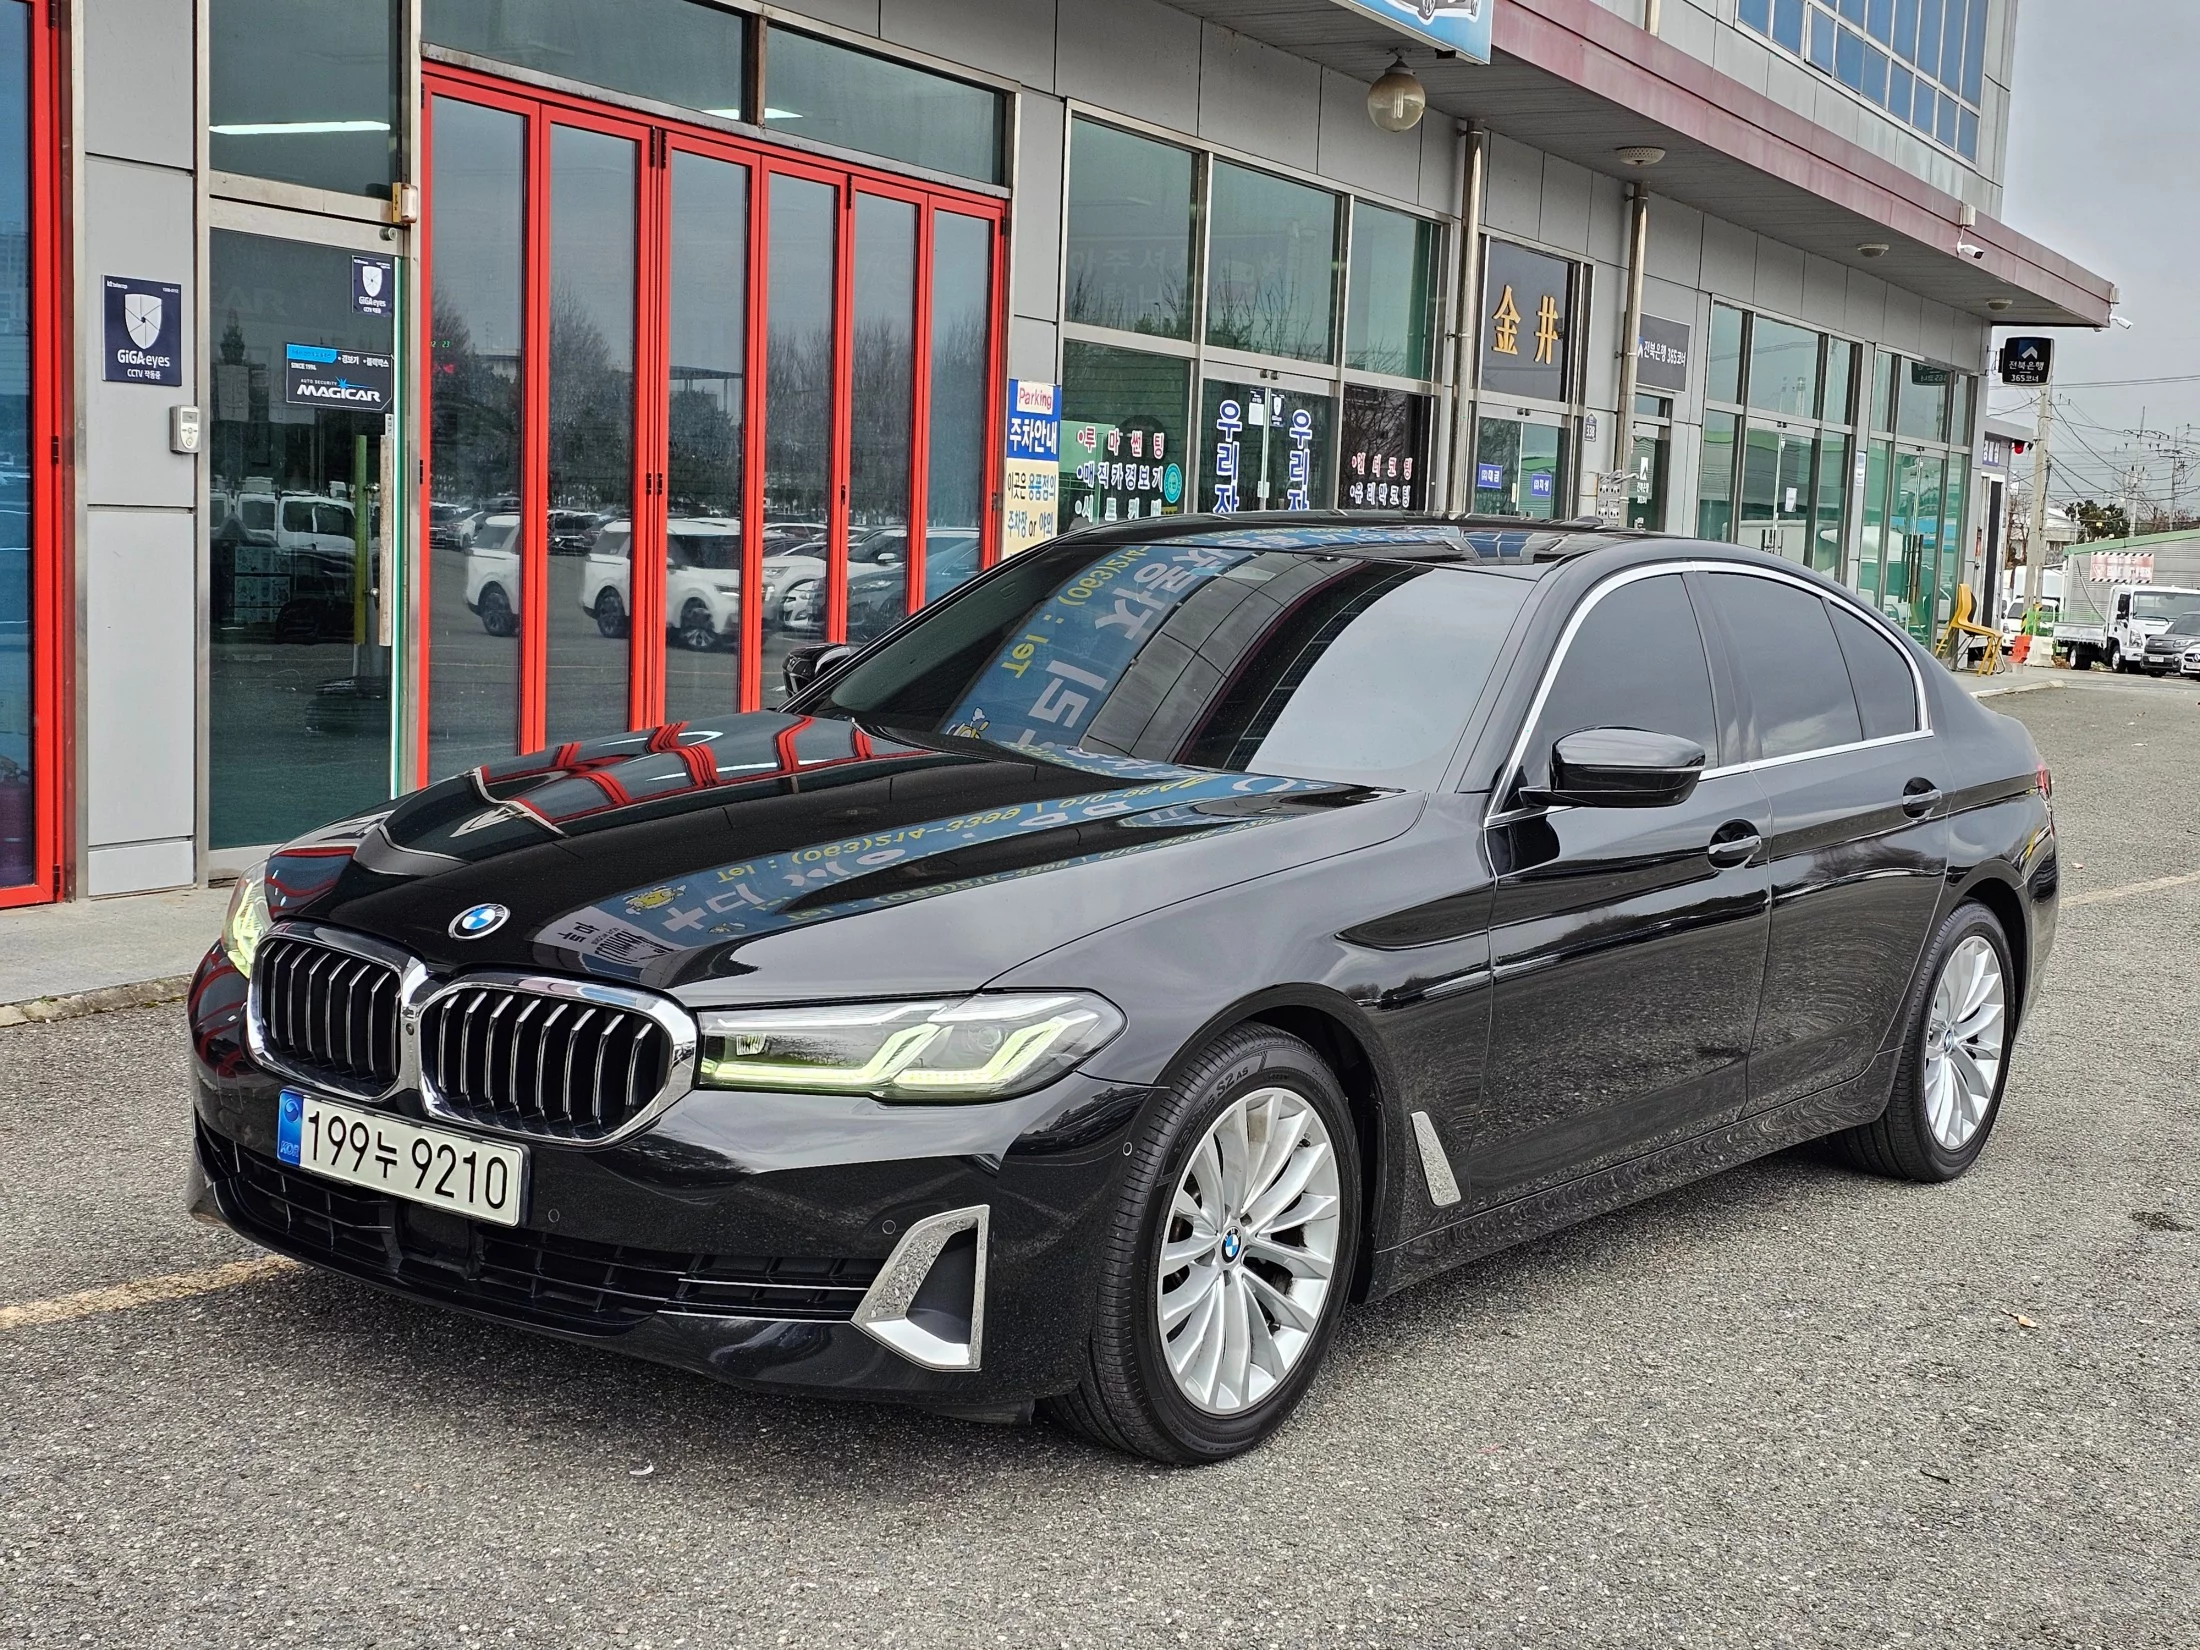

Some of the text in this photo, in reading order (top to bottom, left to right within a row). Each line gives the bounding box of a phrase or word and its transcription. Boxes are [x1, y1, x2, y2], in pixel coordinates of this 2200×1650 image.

[1491, 284, 1559, 364] 金井
[1644, 341, 1667, 362] 전북은행
[127, 368, 143, 378] CCTV
[2008, 360, 2045, 371] 전북은행
[2010, 374, 2039, 383] 365코너
[296, 384, 381, 403] MAGICAR
[1019, 387, 1052, 410] Parking
[1009, 417, 1058, 455] 주차안내
[1007, 472, 1057, 502] 이곳은 용품점의
[1007, 509, 1028, 539] 주차장
[1028, 519, 1037, 537] or
[1217, 1072, 1235, 1097] S2
[1236, 1066, 1249, 1080] AS
[280, 1141, 300, 1157] KOR
[308, 1110, 508, 1209] 199누 9210
